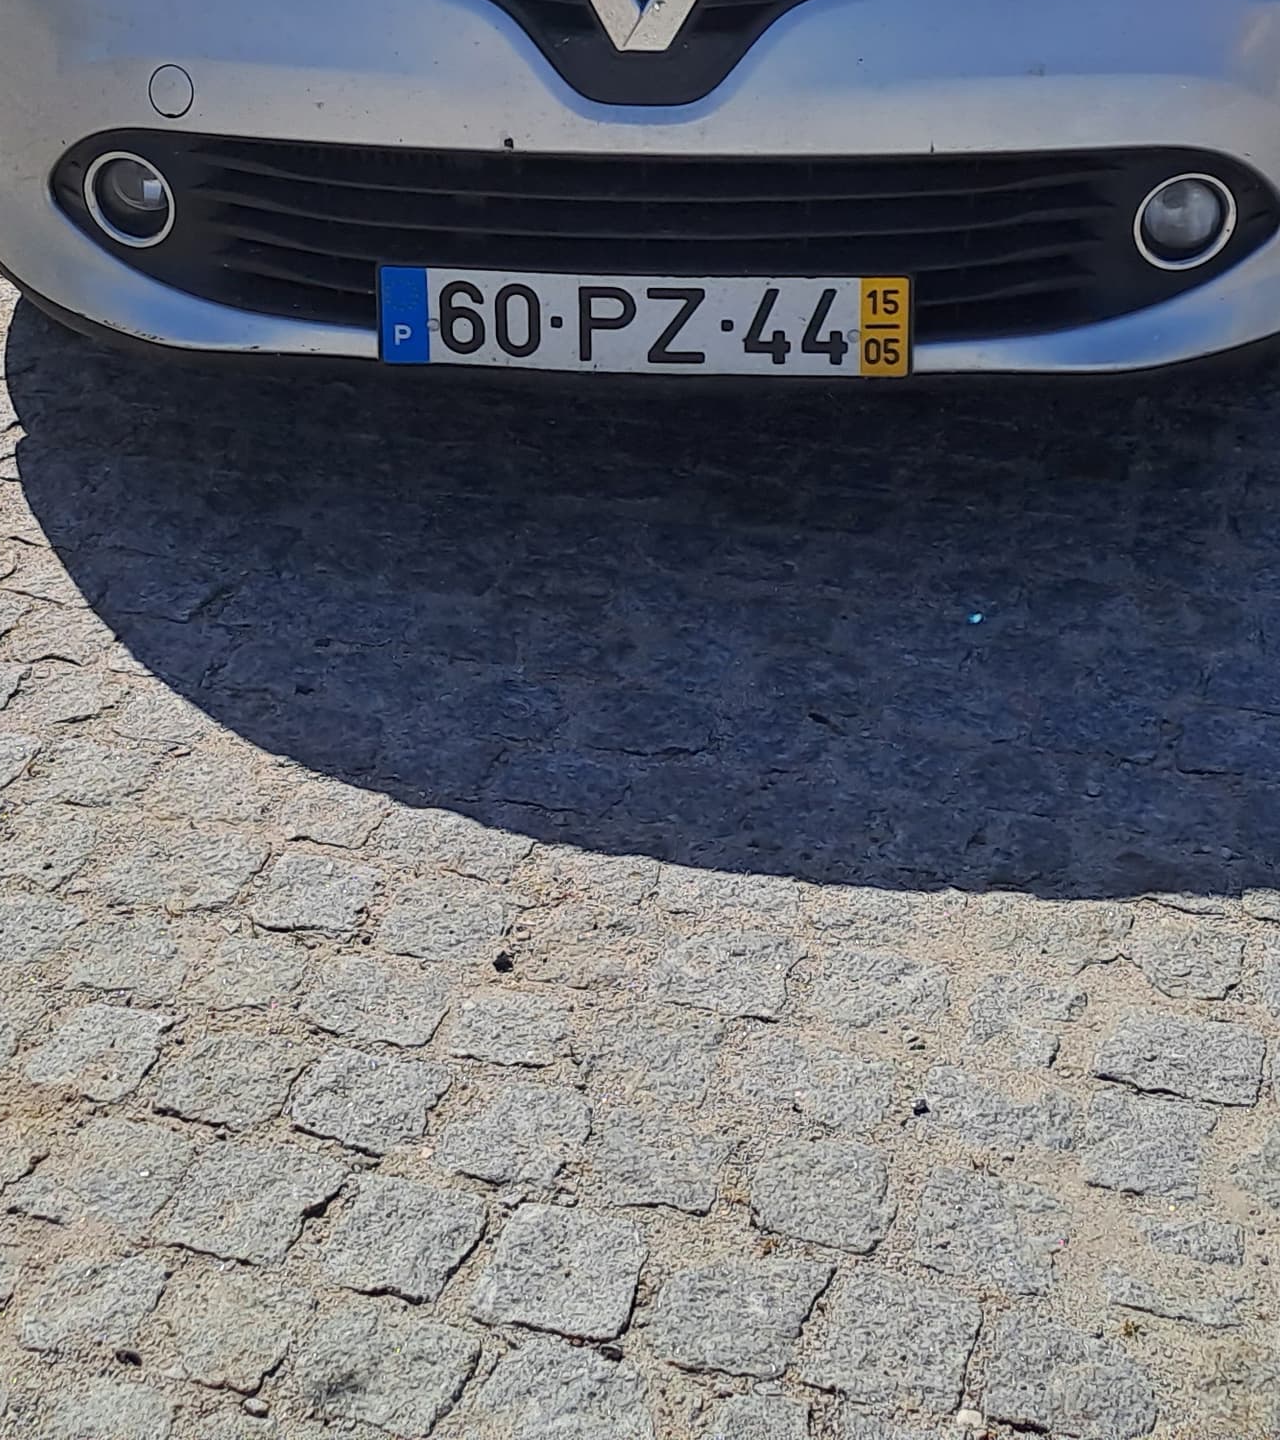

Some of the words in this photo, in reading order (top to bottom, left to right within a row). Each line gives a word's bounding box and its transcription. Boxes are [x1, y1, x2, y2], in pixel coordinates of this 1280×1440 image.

[867, 289, 900, 316] 15
[394, 324, 412, 345] P
[864, 337, 901, 366] 05
